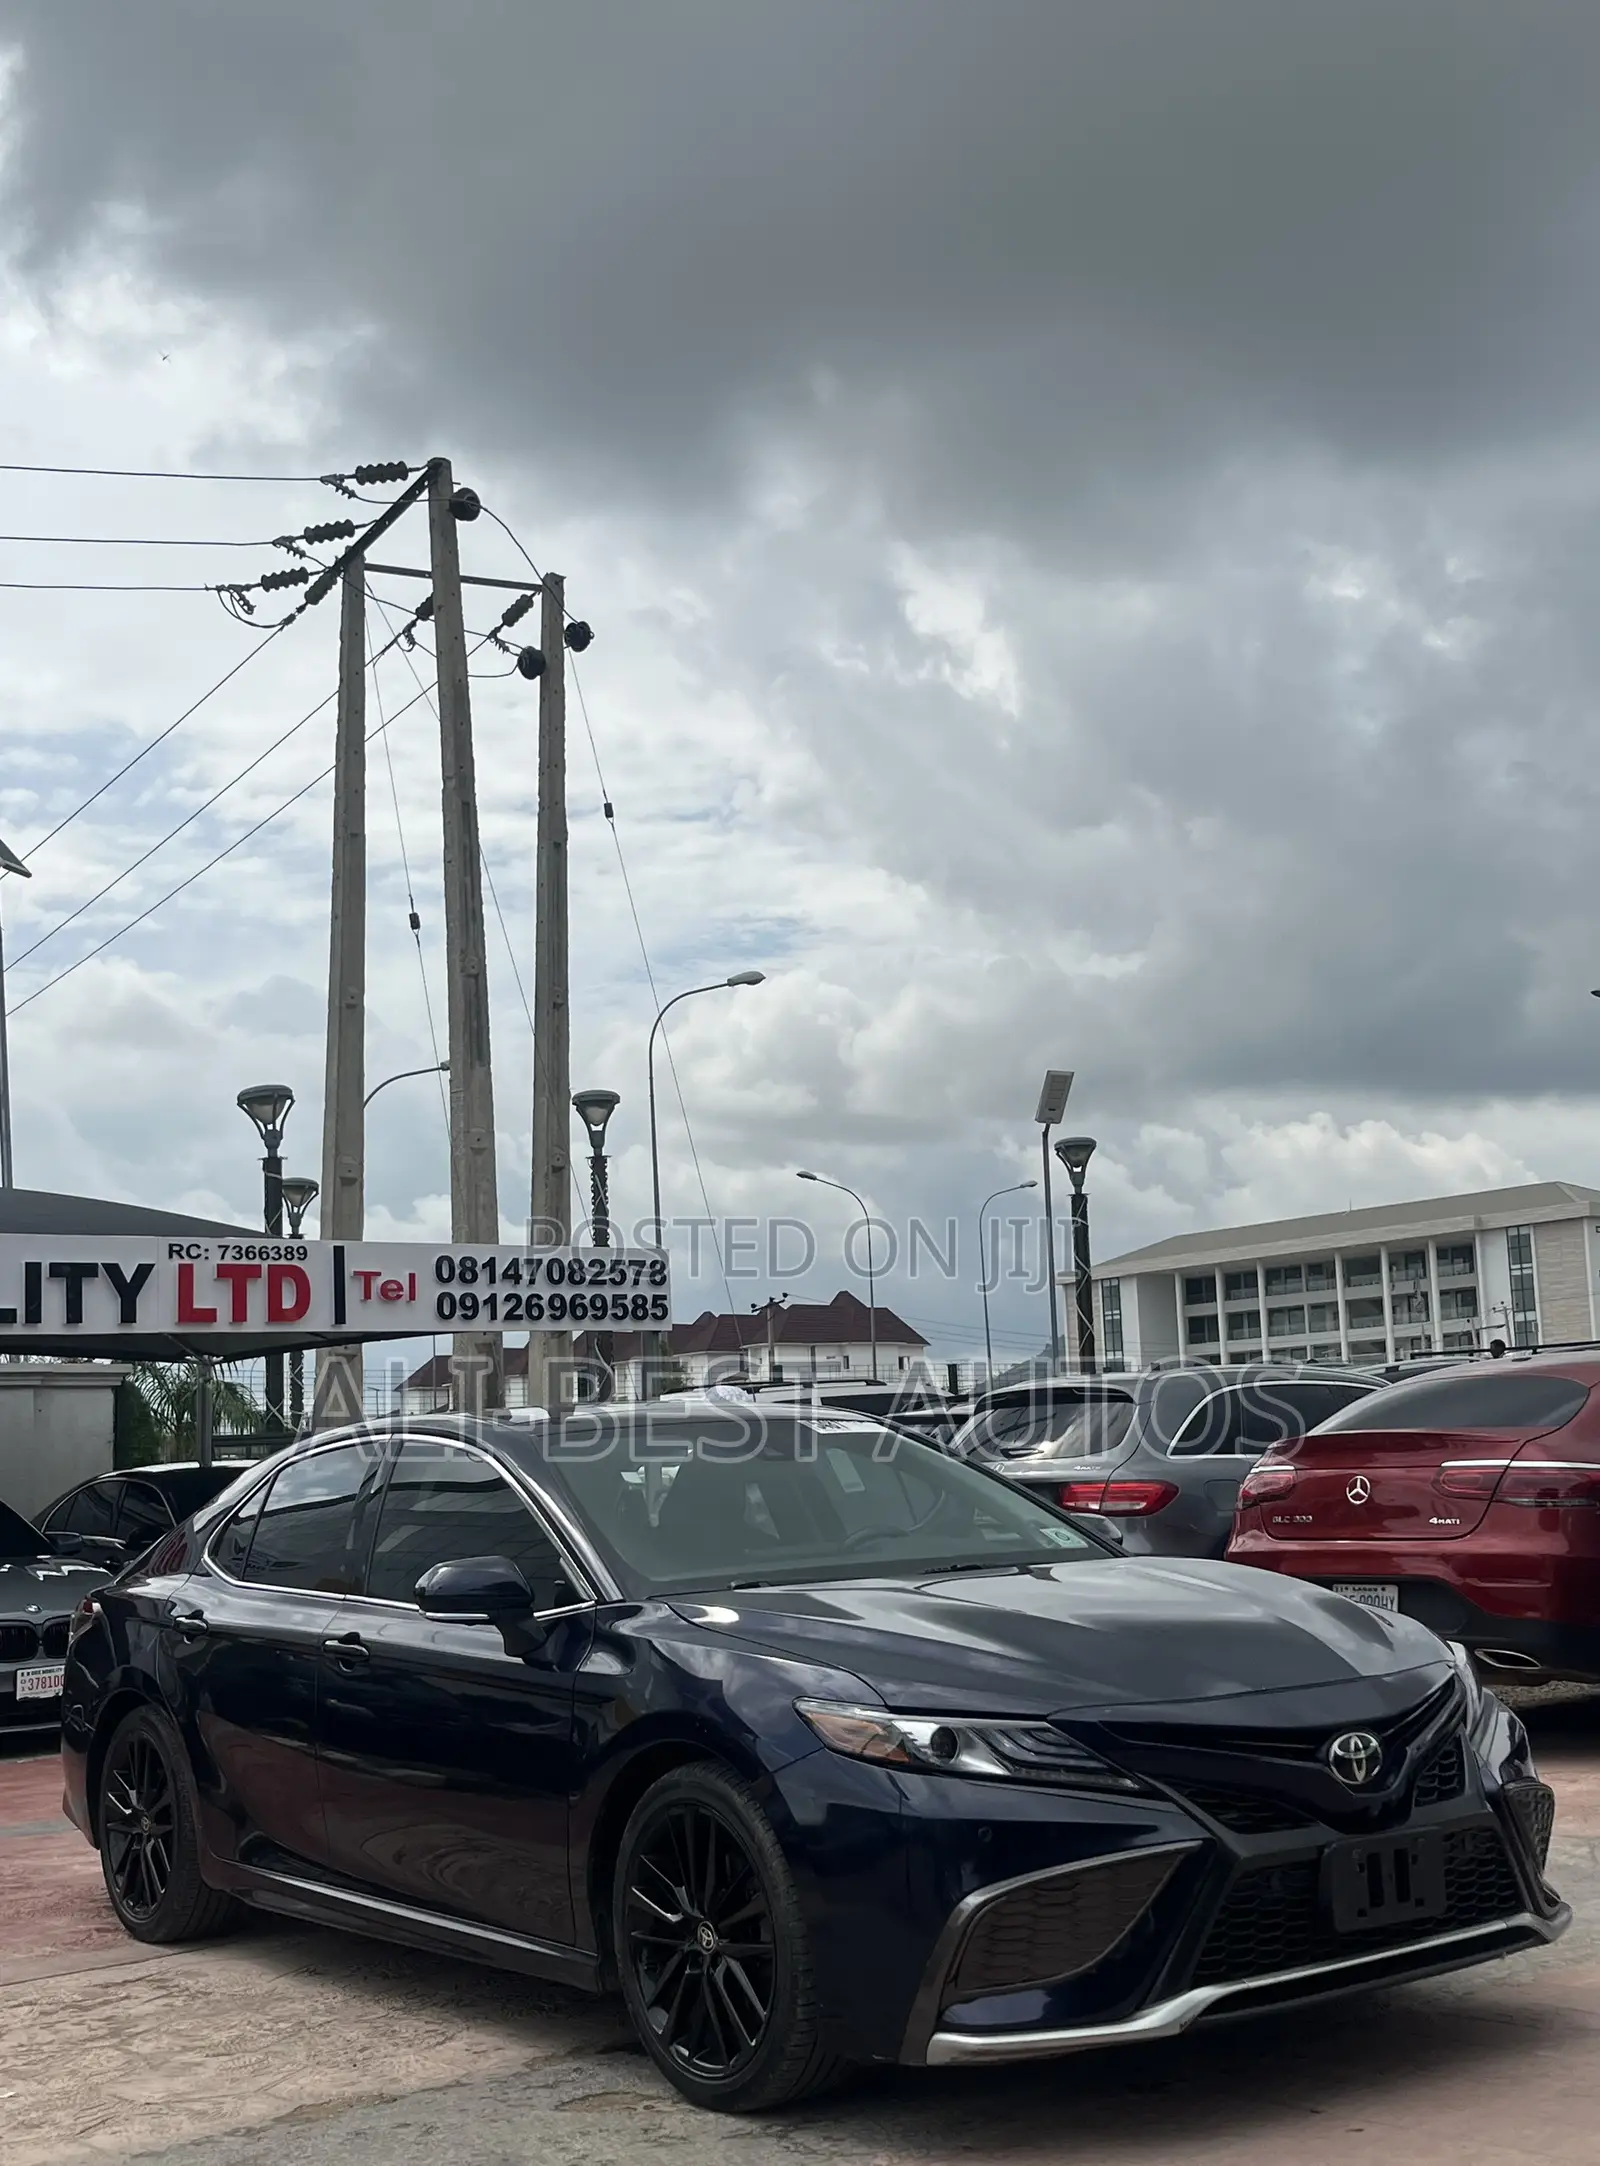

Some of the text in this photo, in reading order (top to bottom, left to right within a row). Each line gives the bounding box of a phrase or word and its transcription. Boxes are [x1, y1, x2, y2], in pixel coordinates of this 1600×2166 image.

[168, 1243, 308, 1261] RC: 7366389
[178, 1263, 312, 1323] LTD
[353, 1255, 667, 1301] Tel 08147082578
[436, 1291, 669, 1321] 09126969585
